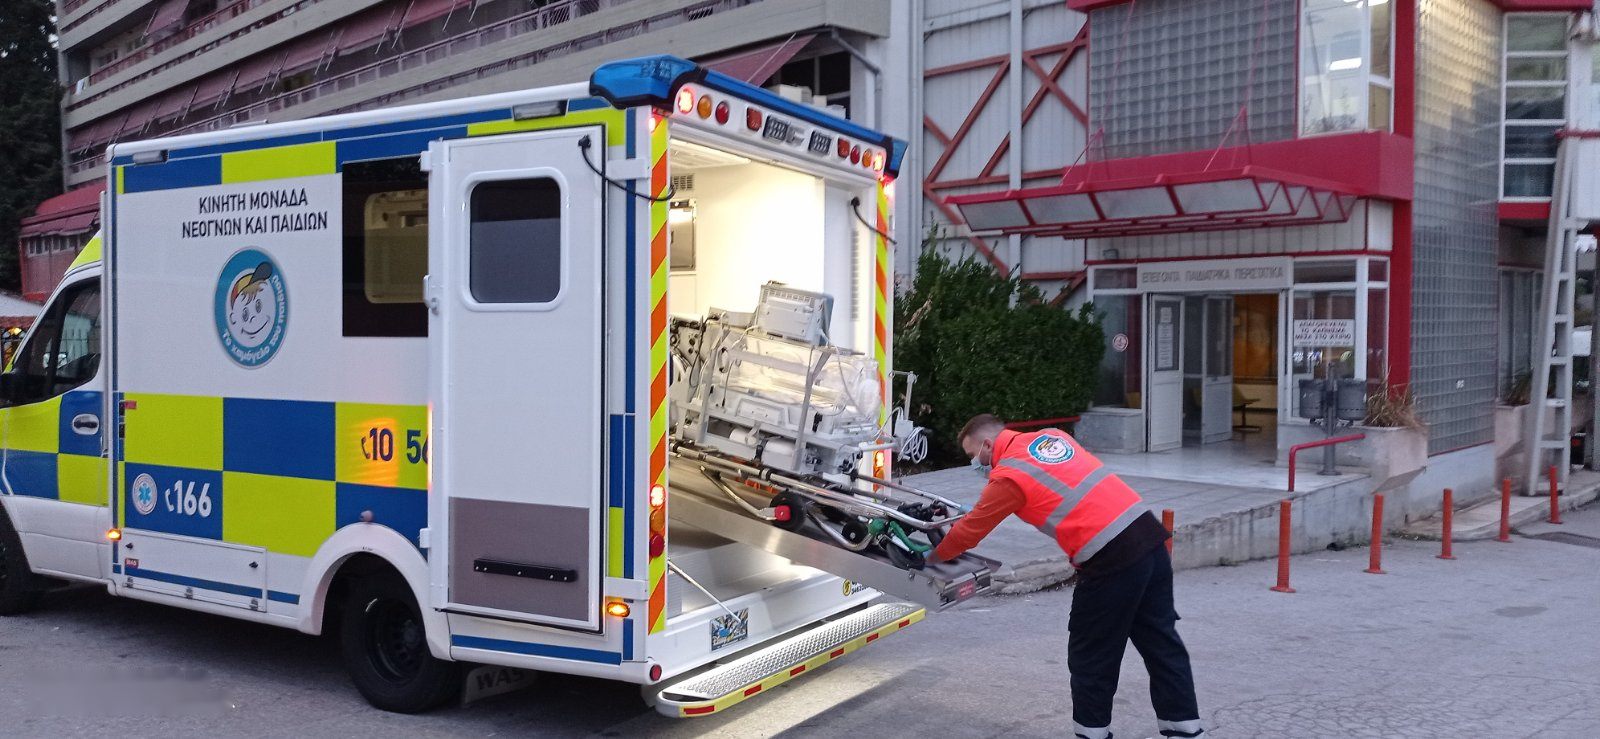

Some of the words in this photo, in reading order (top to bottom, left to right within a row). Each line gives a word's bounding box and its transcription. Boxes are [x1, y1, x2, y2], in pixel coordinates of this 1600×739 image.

[199, 193, 247, 214] ΚΙΝΗΤΗ
[250, 187, 308, 211] ΜΟΝΑΔΑ
[182, 217, 242, 239] ΝΕΟΓΝΩΝ
[245, 215, 267, 235] ΚΑΙ
[271, 210, 328, 234] ΠΑΙΔΙΩΝ
[369, 427, 393, 462] 10
[174, 479, 212, 518] 166
